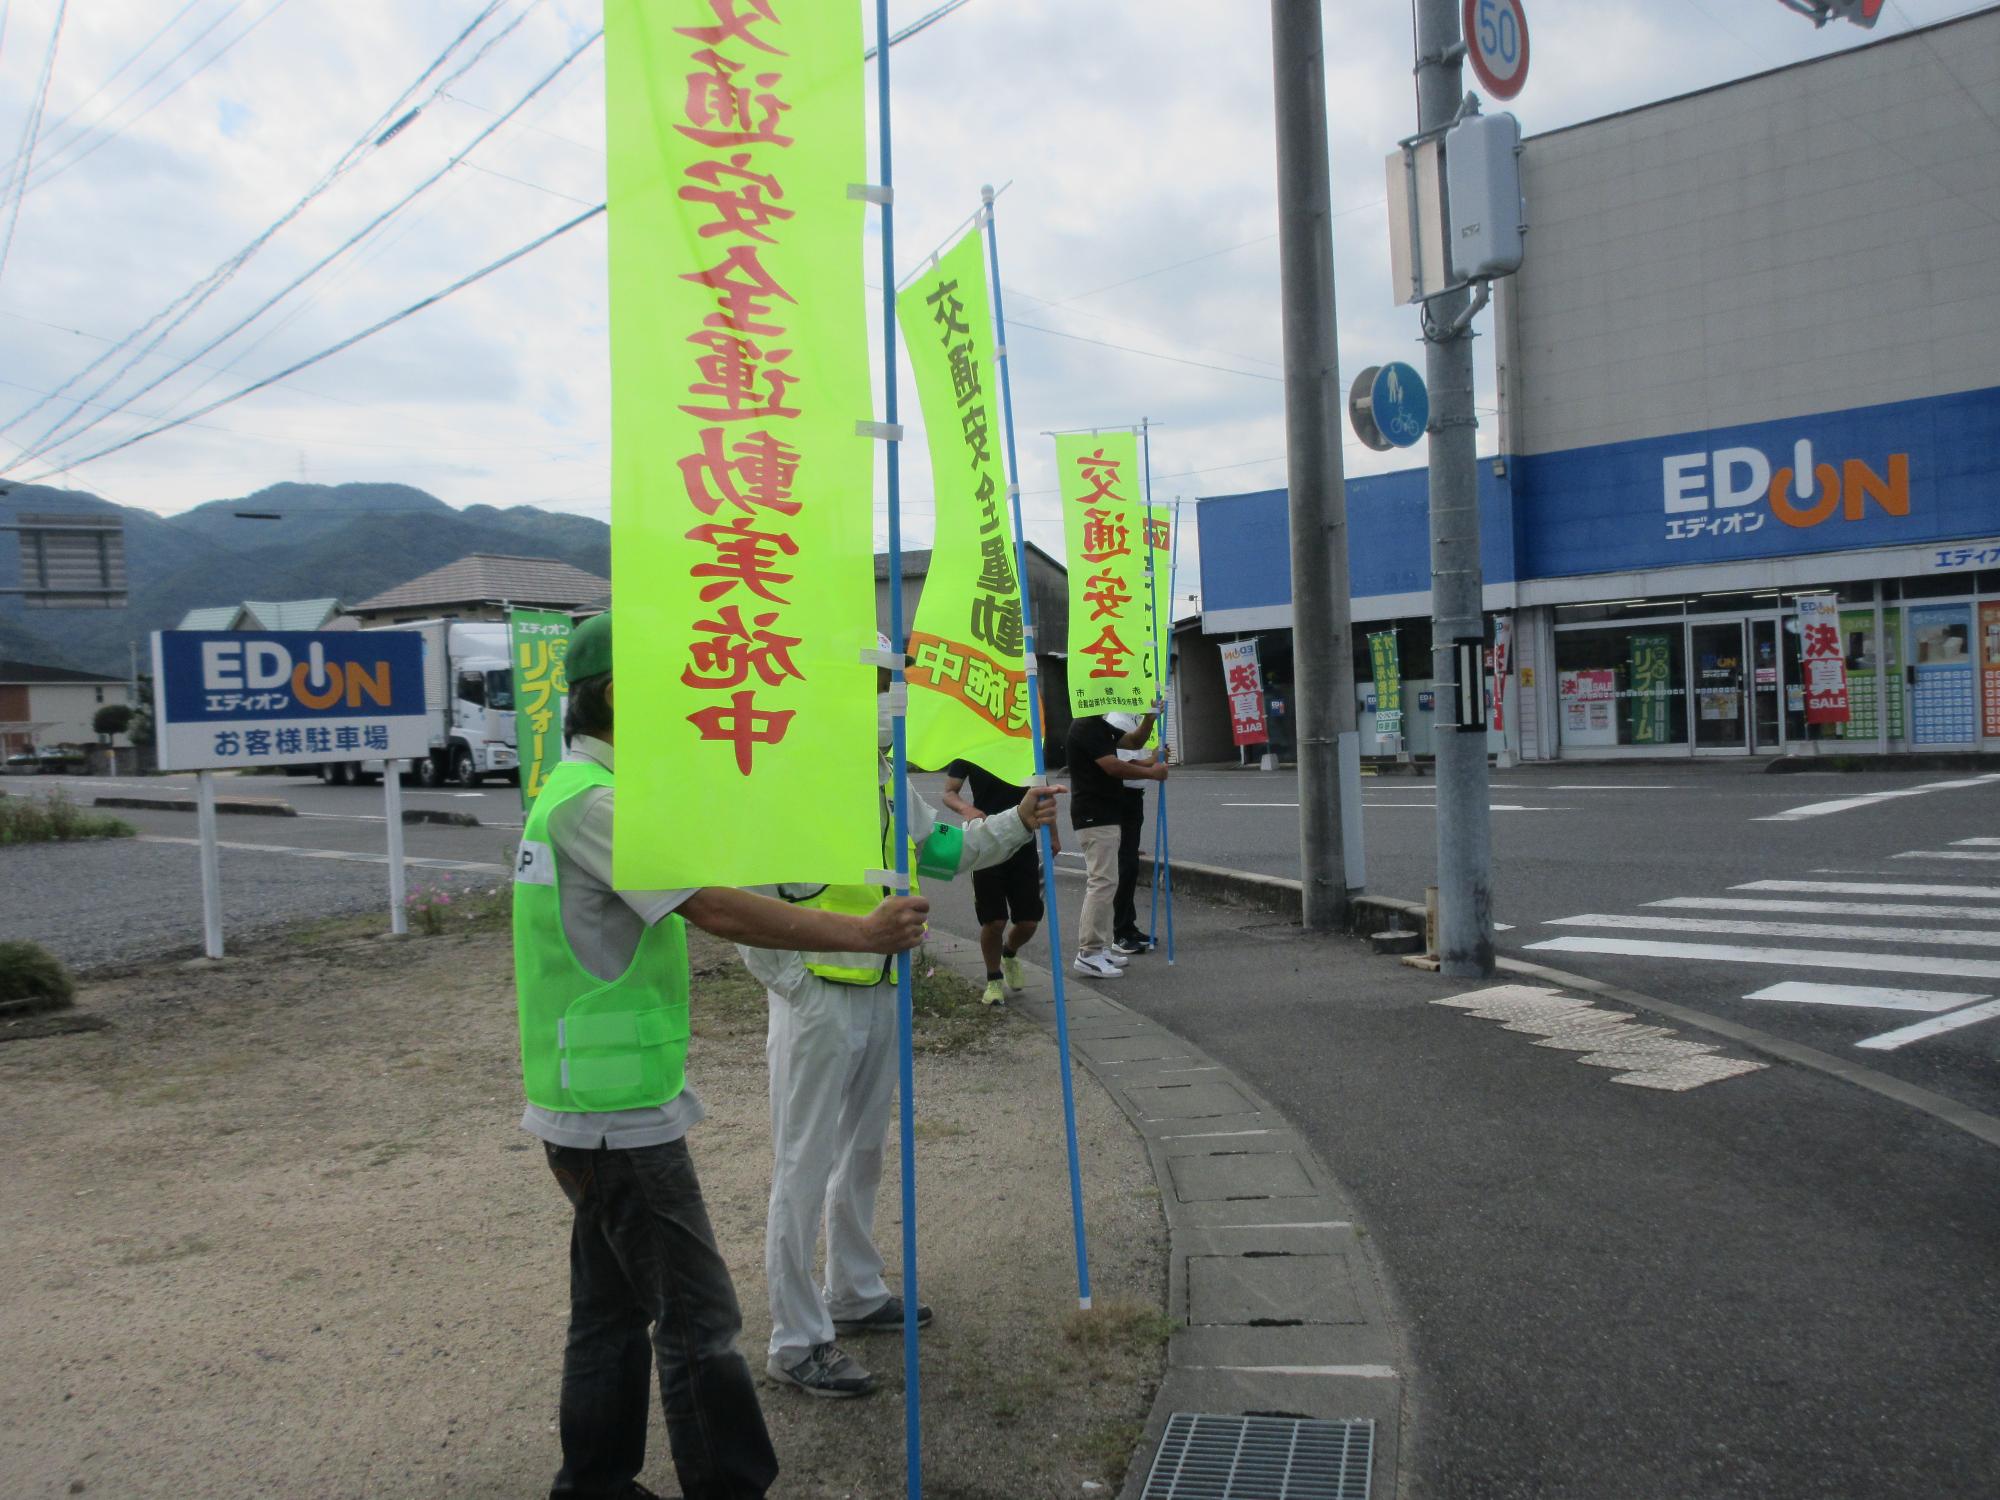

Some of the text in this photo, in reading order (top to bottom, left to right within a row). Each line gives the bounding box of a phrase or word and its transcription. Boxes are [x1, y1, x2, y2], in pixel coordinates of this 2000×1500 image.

[1480, 0, 1517, 63] 50
[1662, 438, 1911, 528] EDION
[1665, 511, 1764, 540] エディオン
[518, 622, 571, 636] エディオン
[201, 640, 391, 709] EDION
[1804, 623, 1846, 696] 決算
[205, 692, 289, 712] エディオン
[518, 640, 554, 798] リフォーム
[1809, 697, 1847, 709] SALE
[213, 724, 390, 757] お客様駐車場
